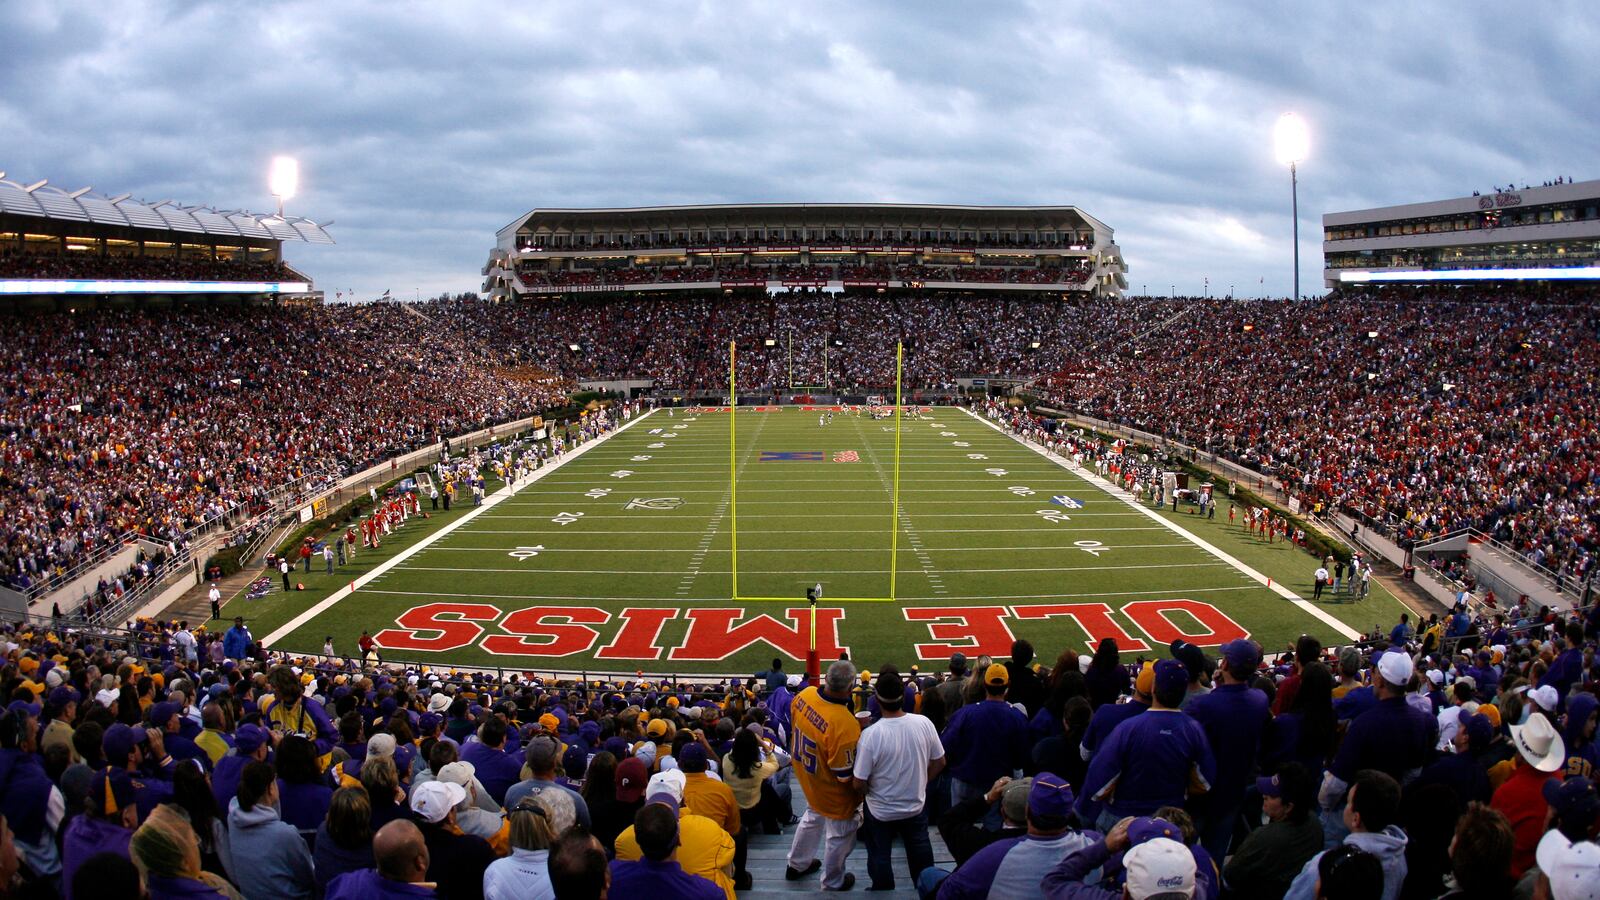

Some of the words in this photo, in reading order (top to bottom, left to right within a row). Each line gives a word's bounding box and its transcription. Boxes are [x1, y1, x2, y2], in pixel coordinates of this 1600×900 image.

[508, 544, 545, 558] 10
[1073, 540, 1111, 553] 10
[371, 602, 851, 662] MISS
[901, 599, 1251, 661] OLE
[804, 705, 829, 734] TIGERS
[793, 726, 817, 774] 15
